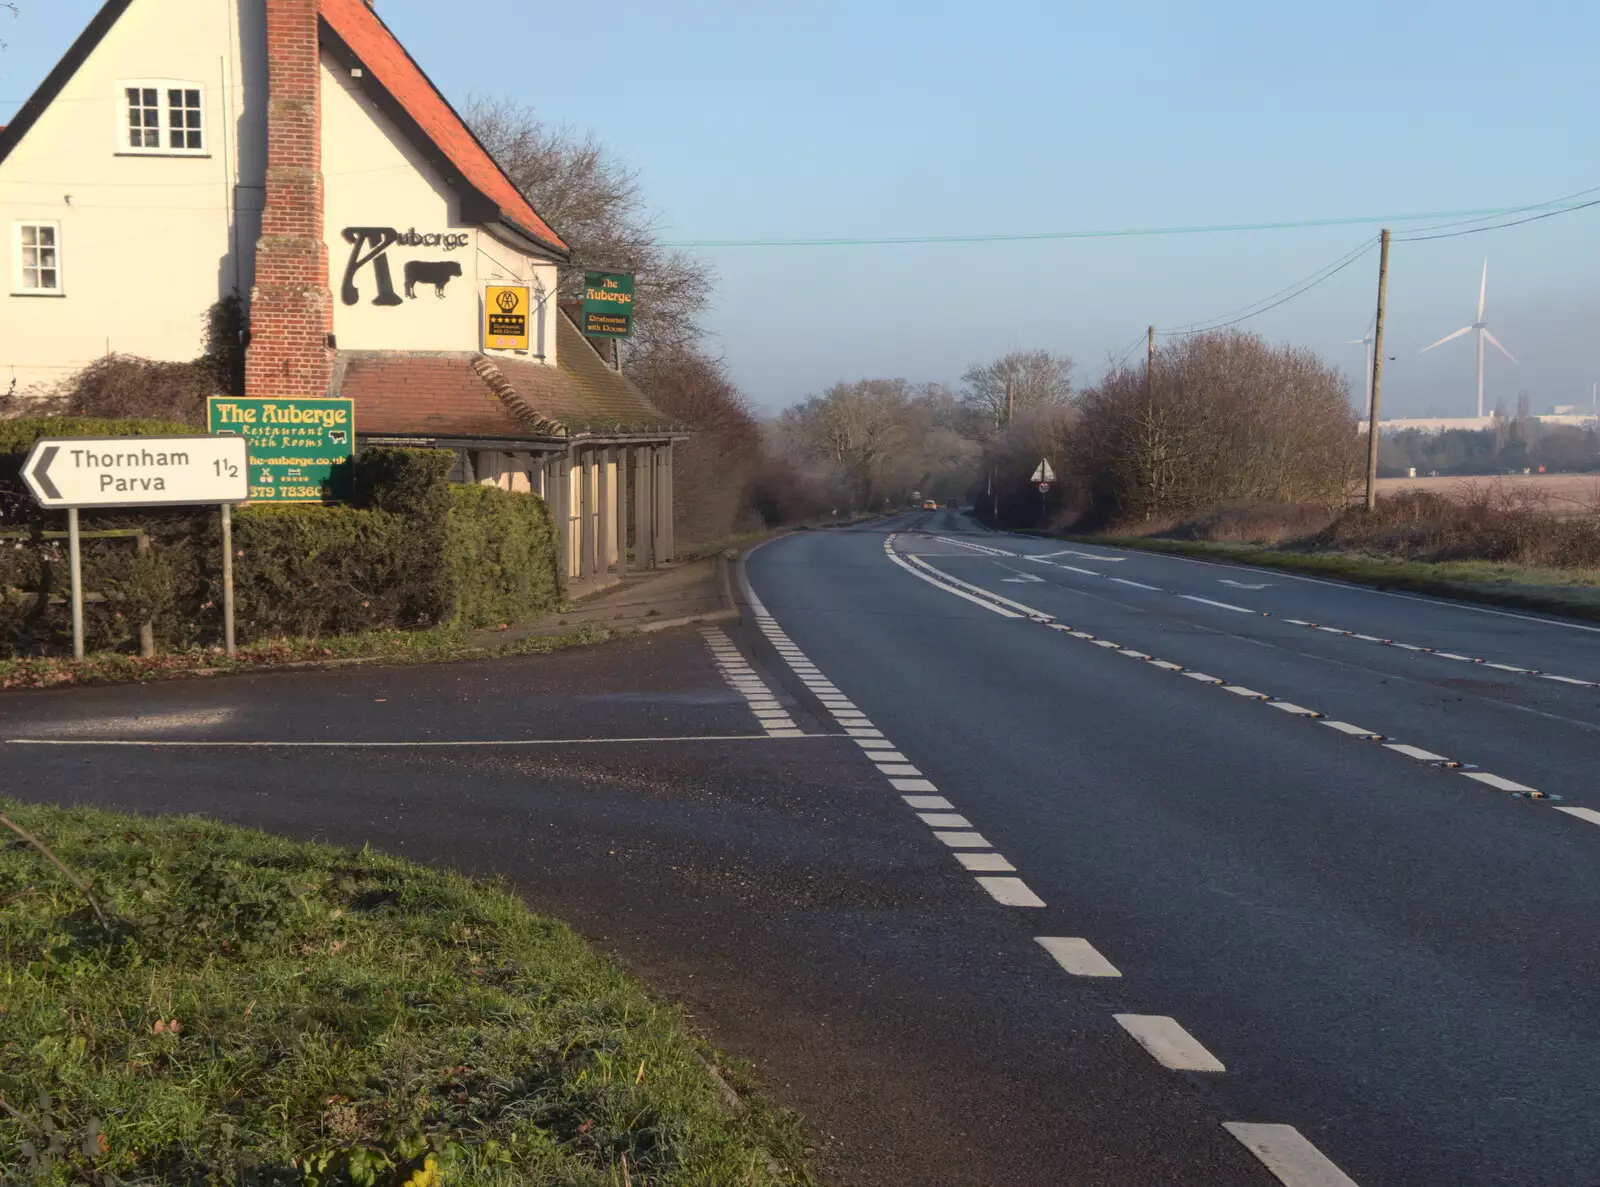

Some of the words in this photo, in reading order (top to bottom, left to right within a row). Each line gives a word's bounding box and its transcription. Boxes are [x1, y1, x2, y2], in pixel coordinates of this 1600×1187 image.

[340, 227, 469, 306] Auberge
[602, 278, 618, 288] The
[586, 288, 632, 304] Auberge
[216, 403, 257, 423] The
[262, 404, 347, 428] Auberge
[242, 425, 324, 436] Restaurant
[281, 436, 323, 448] Rooms
[70, 448, 190, 468] Thornham
[249, 455, 346, 467] he-auberge.co.uk
[99, 473, 166, 493] Parva
